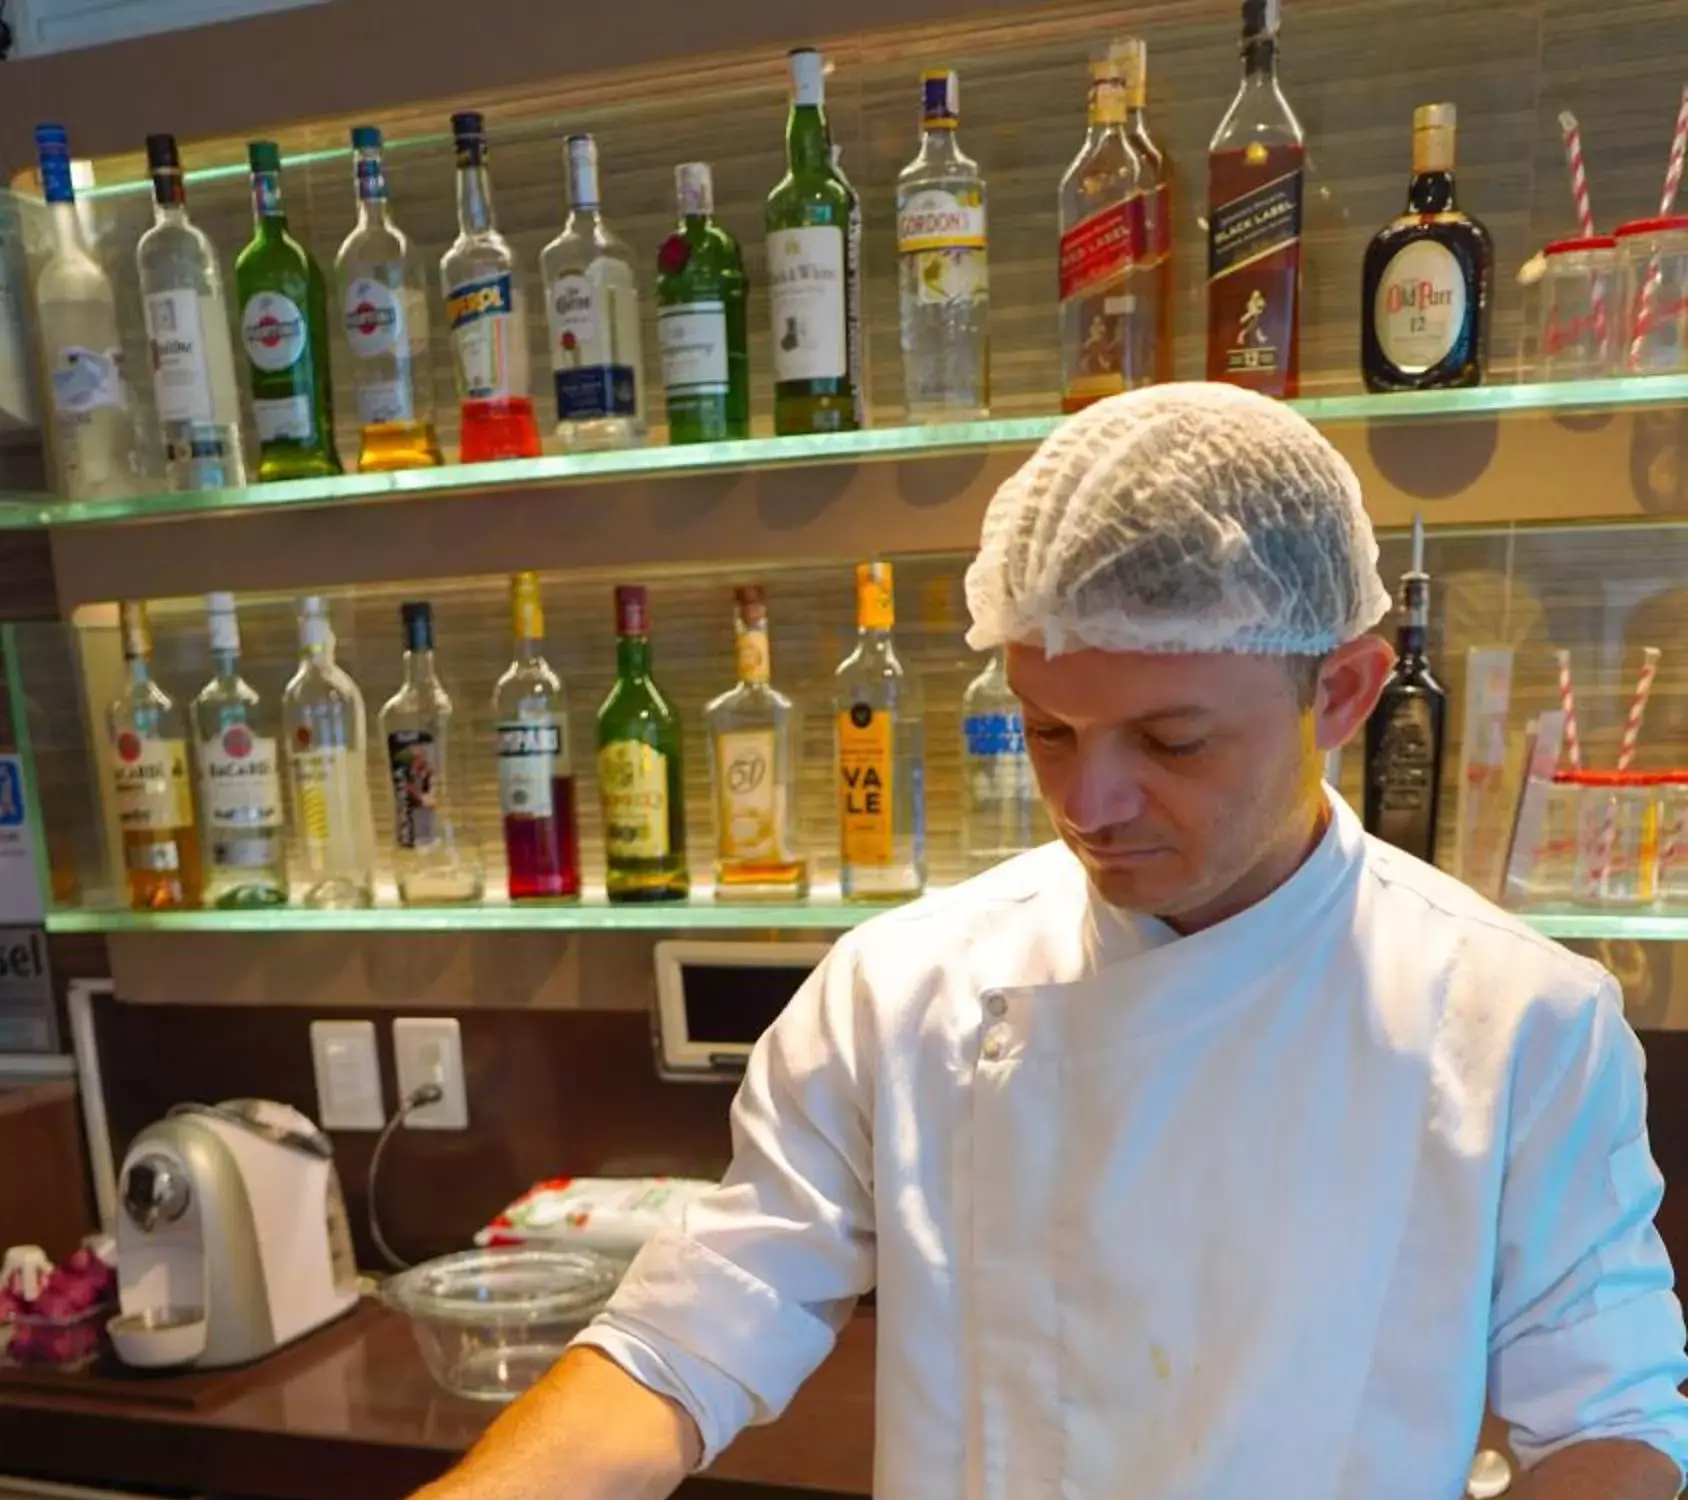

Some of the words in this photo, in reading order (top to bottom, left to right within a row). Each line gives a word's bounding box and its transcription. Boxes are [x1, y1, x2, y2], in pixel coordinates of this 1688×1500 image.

[1214, 217, 1253, 244] BLACK
[1254, 199, 1298, 225] LABEL
[1088, 224, 1131, 254] LABEL
[1409, 315, 1427, 333] 12
[841, 767, 882, 788] VA
[848, 793, 881, 814] LE
